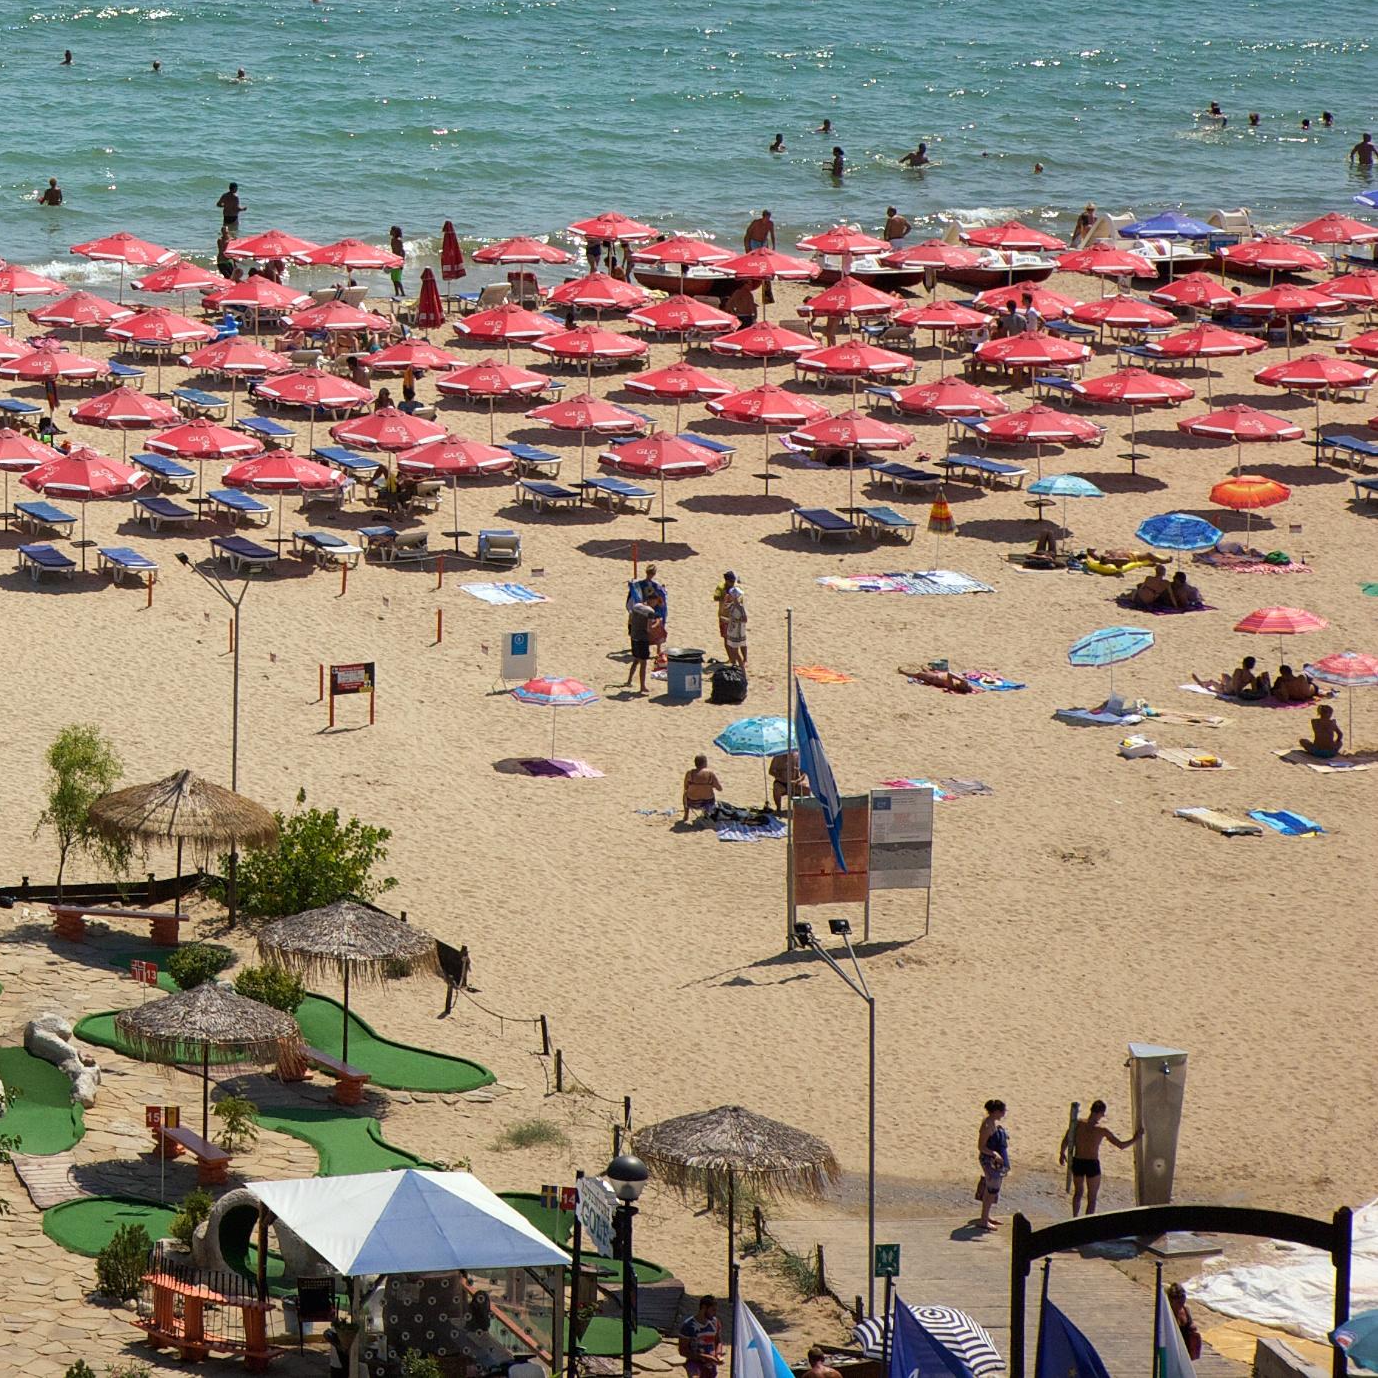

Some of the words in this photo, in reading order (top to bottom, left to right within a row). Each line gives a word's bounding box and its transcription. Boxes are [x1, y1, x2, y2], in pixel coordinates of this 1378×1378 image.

[146, 968, 157, 980] 13
[146, 1112, 160, 1123] 15
[563, 1193, 576, 1204] 14
